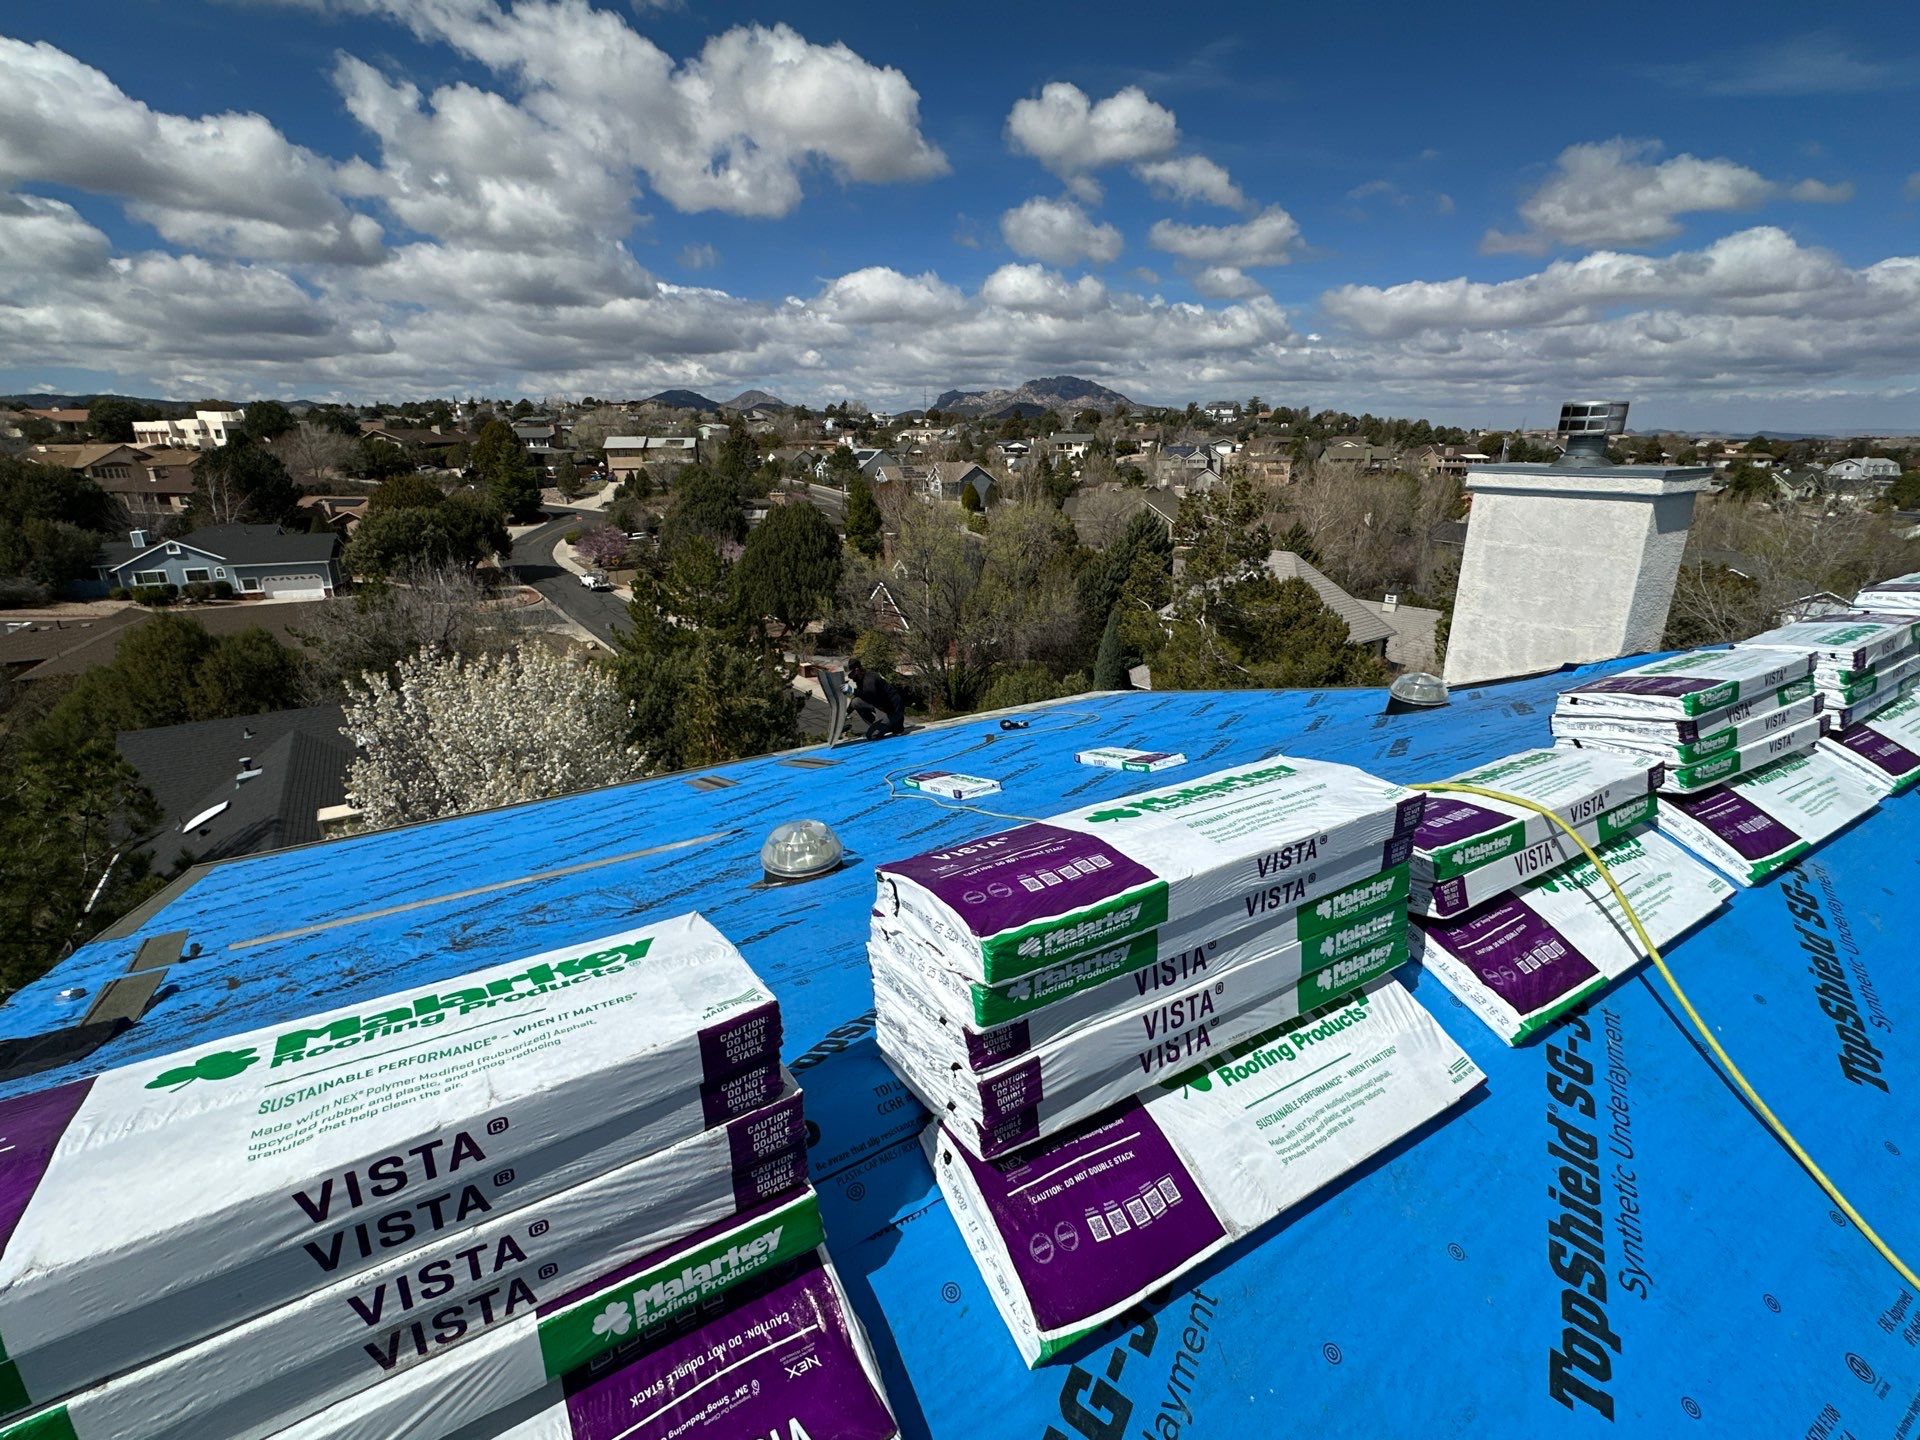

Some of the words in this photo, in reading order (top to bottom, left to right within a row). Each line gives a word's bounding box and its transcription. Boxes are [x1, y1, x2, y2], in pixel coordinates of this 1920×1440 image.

[1257, 834, 1327, 878] VISTA®
[1245, 873, 1316, 917] VISTA®
[1333, 876, 1395, 911] Malarkey
[1812, 863, 1860, 956] Underlayment
[1044, 902, 1143, 949] Malarkey
[1335, 910, 1395, 948] Malarkey
[1034, 944, 1132, 994] Malarkey
[1134, 940, 1217, 996] VISTA®
[1333, 942, 1394, 982] Malarkey
[274, 937, 656, 1057] Malarkey
[702, 1005, 730, 1020] MADE
[1143, 981, 1224, 1041] VISTA®
[1847, 957, 1894, 1034] Synthetic
[270, 1012, 446, 1070] Roofing
[720, 1016, 769, 1042] CAUTION:
[726, 1034, 767, 1057] DOUBLE
[727, 1034, 741, 1049] DO
[744, 1026, 765, 1040] NOT
[258, 1069, 374, 1115] SUSTAINABLE
[513, 1017, 555, 1036] WHEN
[558, 1012, 570, 1022] IT
[731, 1045, 764, 1064] STACK
[1217, 1043, 1296, 1087] Roofing
[248, 1121, 318, 1152] upcycled
[322, 1102, 364, 1124] rubber
[368, 1093, 392, 1107] and
[395, 1081, 441, 1100] plastic,
[445, 1071, 468, 1083] and
[471, 1038, 562, 1075] smog-reducing
[251, 1122, 292, 1139] Made
[297, 1104, 330, 1125] with
[366, 1076, 416, 1097] Polymer
[419, 1059, 474, 1082] Modified
[554, 1020, 598, 1036] Asphalt,
[721, 1066, 768, 1092] CAUTION:
[727, 1088, 742, 1099] DO
[745, 1076, 764, 1090] NOT
[727, 1085, 767, 1108] DOUBLE
[1256, 1100, 1300, 1130] SUSTAINABLE
[1346, 1064, 1367, 1078] WHEN
[1604, 1009, 1634, 1161] Underlayment
[733, 1096, 764, 1113] STACK
[747, 1109, 793, 1135] CAUTION:
[1001, 1097, 1025, 1114] STACK
[247, 1133, 314, 1162] granules
[318, 1120, 346, 1134] that
[350, 1109, 379, 1124] help
[382, 1095, 417, 1112] clean
[419, 1089, 441, 1100] the
[753, 1130, 767, 1142] DO
[770, 1119, 789, 1133] NOT
[753, 1126, 790, 1152] DOUBLE
[751, 1152, 797, 1178] CAUTION:
[758, 1138, 788, 1157] STACK
[292, 1117, 509, 1224] VISTA®
[756, 1171, 771, 1184] DO
[773, 1161, 792, 1176] NOT
[757, 1170, 794, 1193] DOUBLE
[762, 1180, 792, 1197] STACK
[1031, 1184, 1065, 1204] CAUTION:
[1064, 1178, 1075, 1188] DO
[1074, 1171, 1088, 1183] NOT
[1088, 1160, 1114, 1176] DOUBLE
[1113, 1150, 1135, 1166] STACK
[303, 1168, 515, 1272] VISTA®
[1608, 1166, 1653, 1300] Synthetic
[347, 1219, 549, 1327] VISTA®
[633, 1225, 783, 1316] Malarkey
[363, 1262, 558, 1370] VISTA®
[636, 1288, 697, 1329] Roofing
[745, 1311, 789, 1339] CAUTION:
[708, 1343, 725, 1361] NOT
[728, 1335, 742, 1348] DO
[667, 1355, 704, 1385] DOUBLE
[785, 1355, 822, 1379] NEX
[630, 1380, 664, 1408] STACK
[668, 1395, 729, 1439] Smog-Reducing
